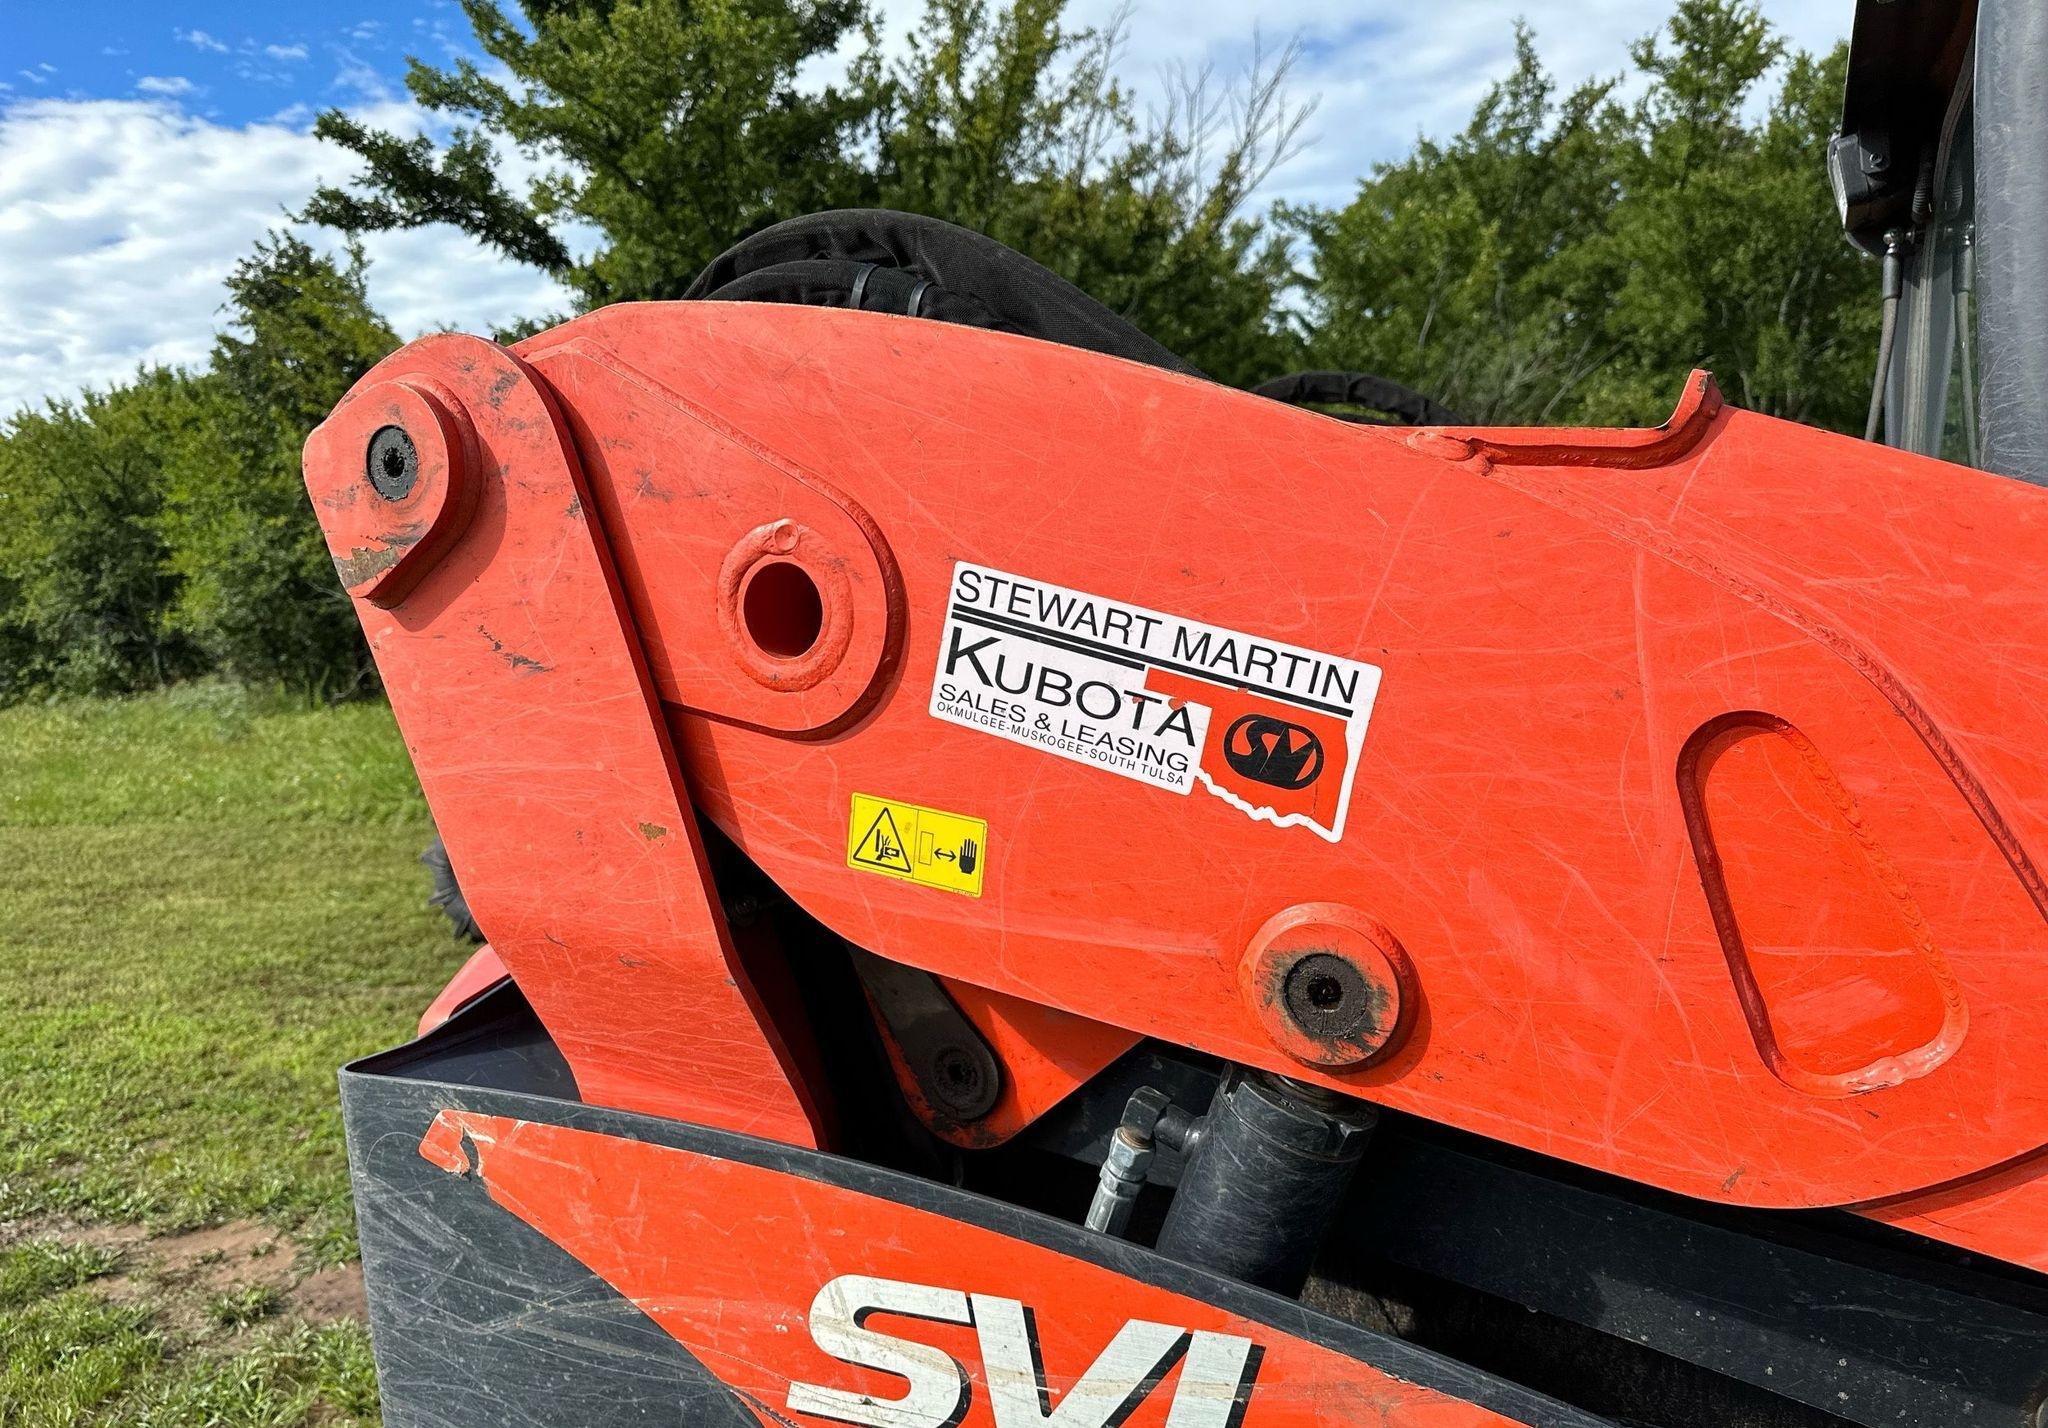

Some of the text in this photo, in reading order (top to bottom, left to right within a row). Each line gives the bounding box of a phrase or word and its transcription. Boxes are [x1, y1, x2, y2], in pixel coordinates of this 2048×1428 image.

[945, 627, 1197, 748] KUBOTA
[955, 570, 1359, 704] STEWART MARTIN
[936, 702, 1185, 786] OKMULGEE-MUSKOGEE-SOUTH TULSA
[939, 683, 1190, 773] SALES & LEASING
